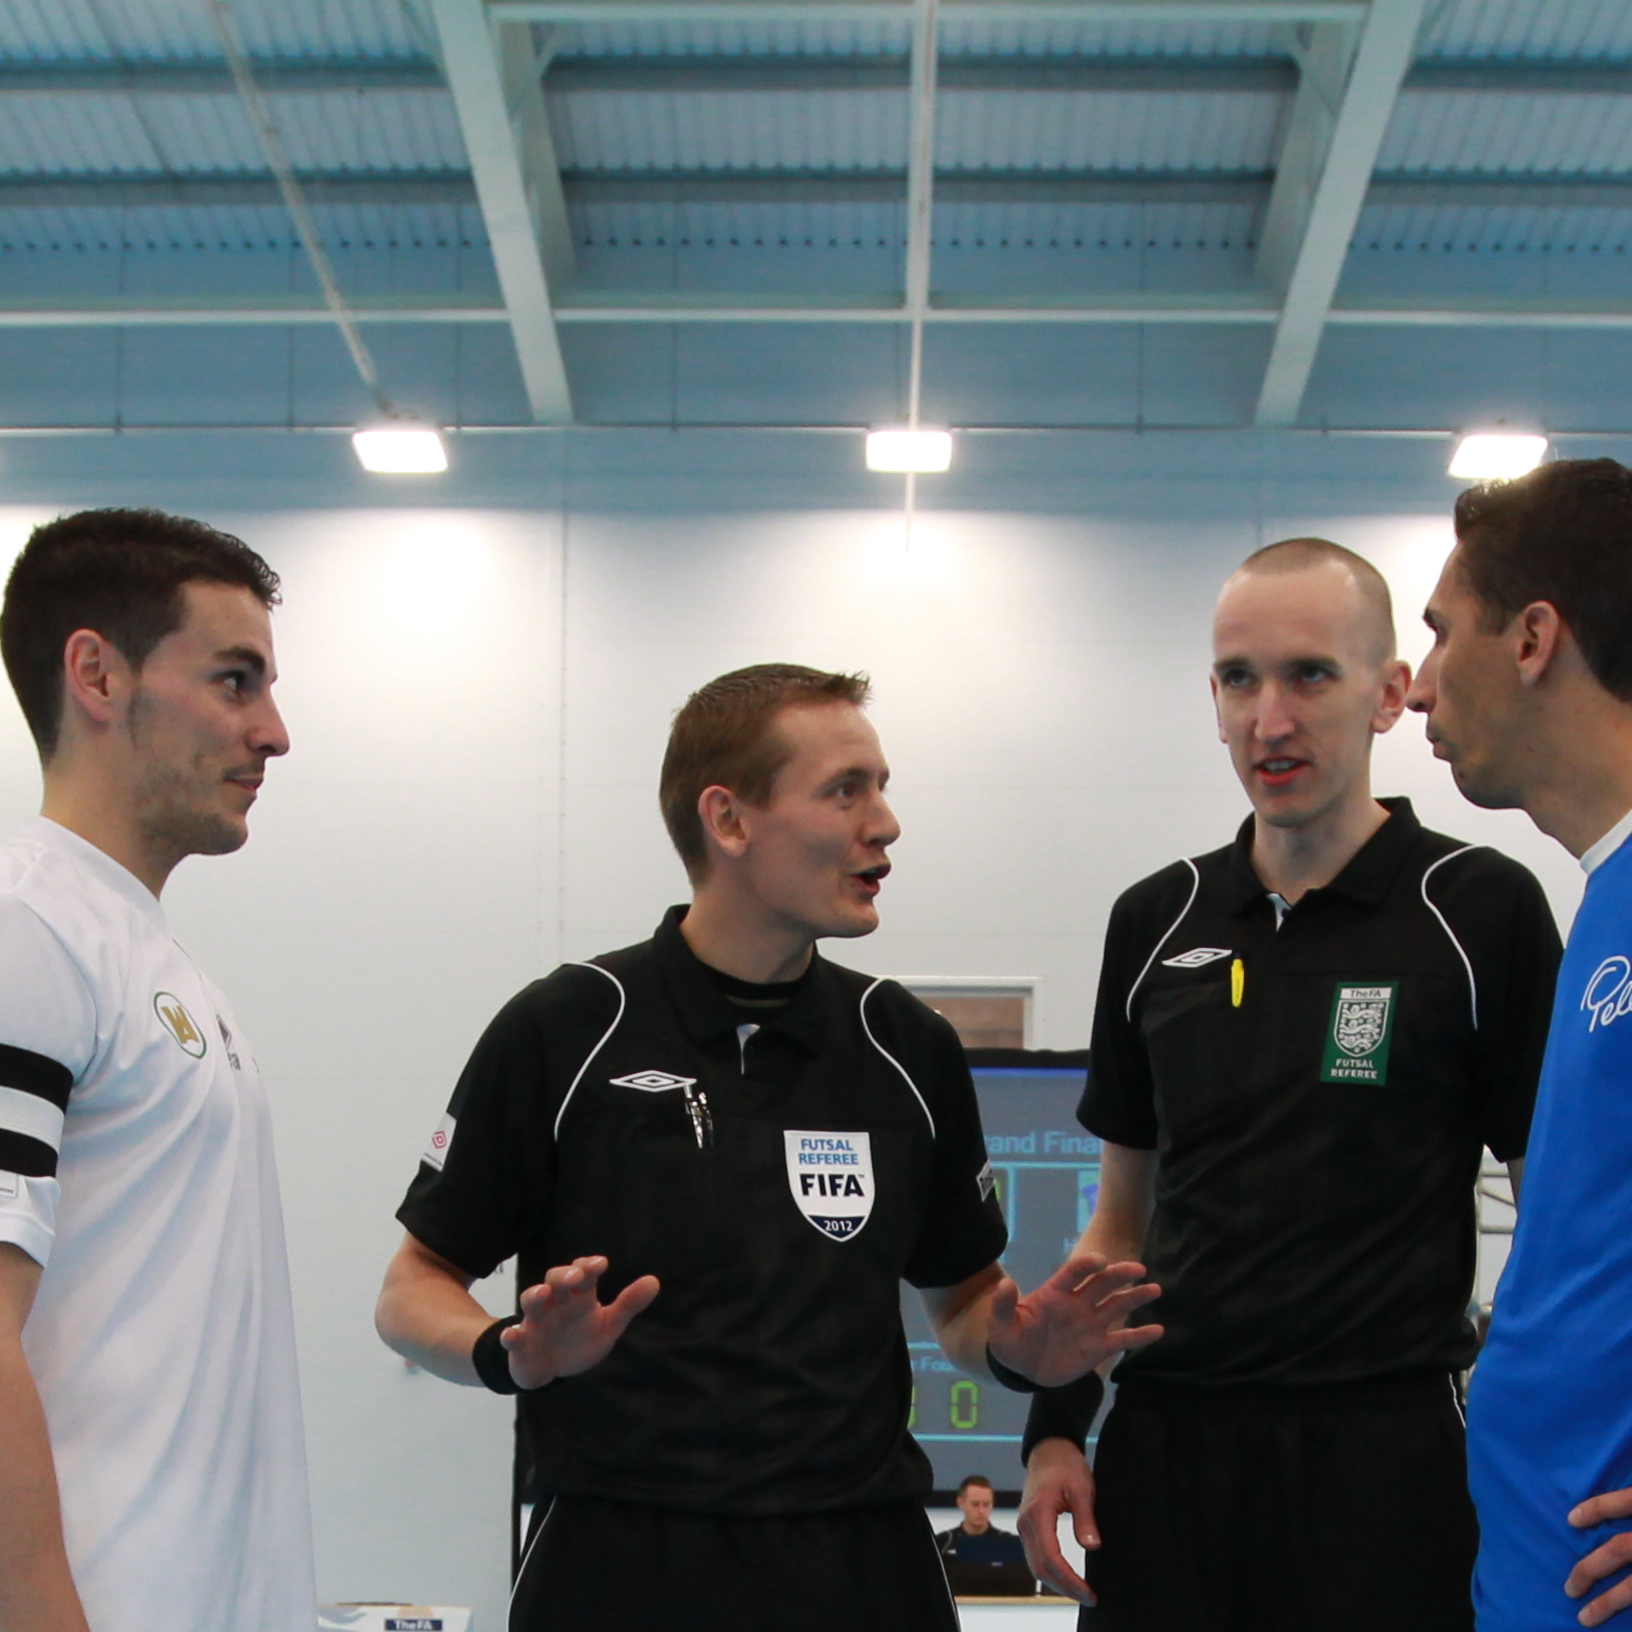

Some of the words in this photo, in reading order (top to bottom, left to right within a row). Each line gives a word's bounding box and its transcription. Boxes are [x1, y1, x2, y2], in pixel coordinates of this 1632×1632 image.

[1335, 1058, 1374, 1068] FUTSAL
[1330, 1068, 1378, 1079] REFEREE
[800, 1138, 854, 1151] FUTSAL
[798, 1153, 859, 1165] REFEREE
[799, 1173, 865, 1197] FIFA
[824, 1220, 854, 1232] 2012
[951, 1380, 978, 1429] 0
